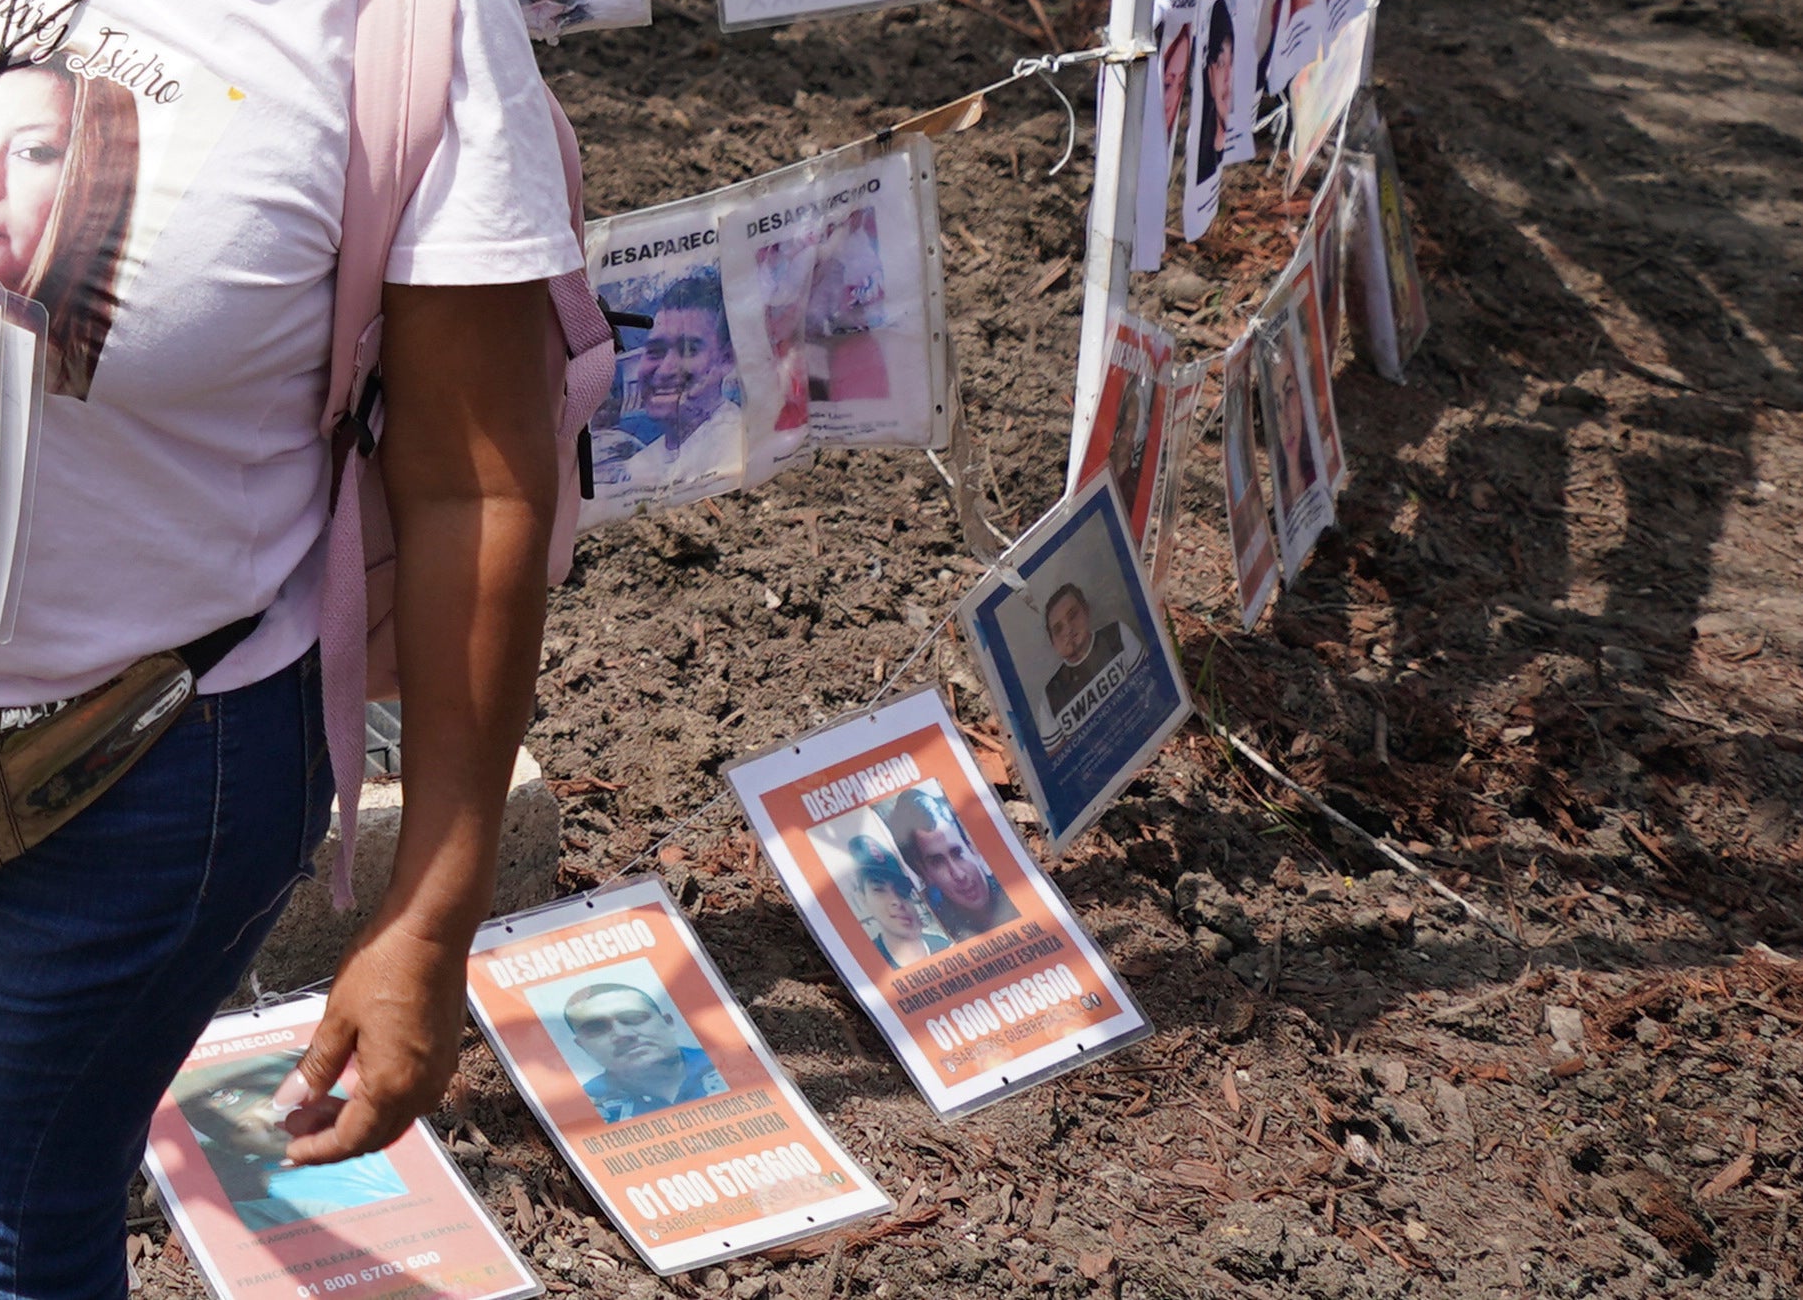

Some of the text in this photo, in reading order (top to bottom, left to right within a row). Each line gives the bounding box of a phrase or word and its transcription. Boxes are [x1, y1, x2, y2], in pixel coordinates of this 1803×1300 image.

[66, 27, 183, 104] Isidro
[1061, 657, 1128, 731] SWAGGY
[801, 751, 923, 824] DESAPARECIDO
[487, 918, 656, 989] DESAPARECIDO
[897, 934, 1065, 1015] CARLOS OMAR RAMIREZ ESPARZA
[926, 963, 1083, 1051] 01 800 6703600
[602, 1111, 790, 1177] JULIO CESAR CAZARES RIVERA
[626, 1141, 822, 1220] 01 800 6703600
[297, 1250, 440, 1298] 01 800 6703 600
[314, 1246, 373, 1270] ELEAZAR
[422, 1220, 472, 1241] BERNAL
